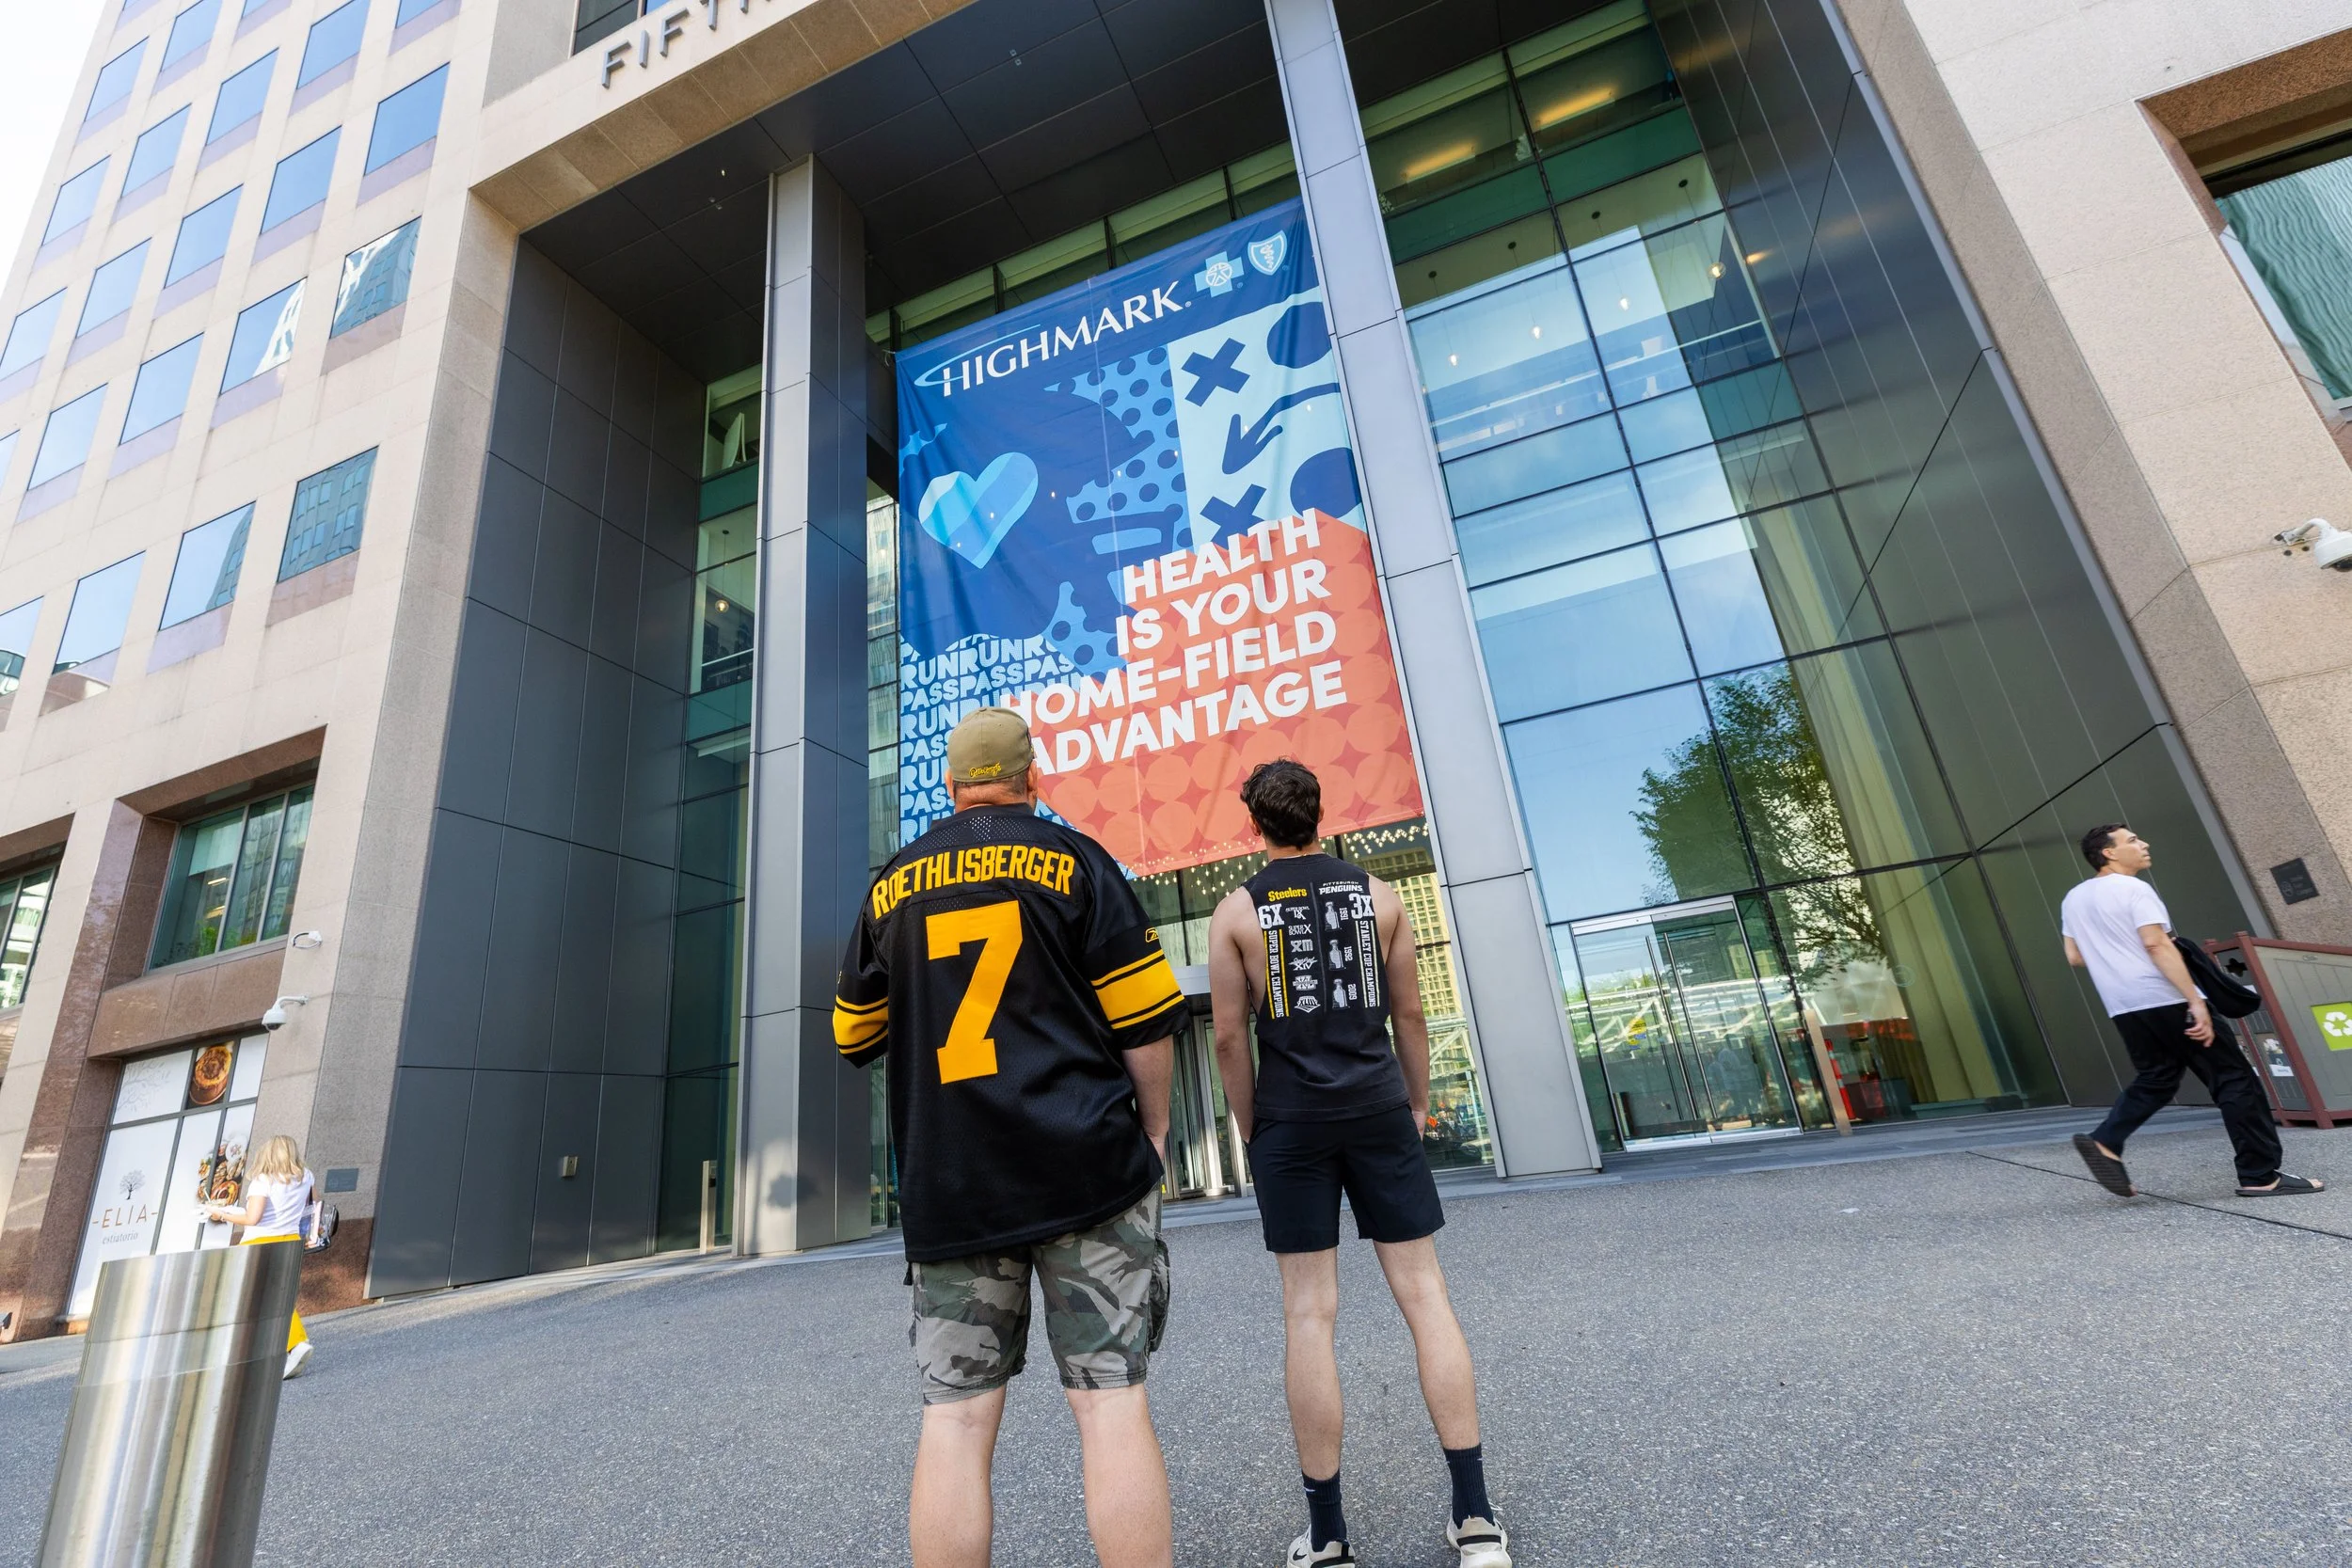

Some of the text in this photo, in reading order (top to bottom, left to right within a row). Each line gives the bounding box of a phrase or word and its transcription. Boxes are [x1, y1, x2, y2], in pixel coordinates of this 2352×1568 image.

[601, 0, 771, 88] FIFT
[1123, 508, 1321, 604] HEALTH
[1116, 559, 1330, 655] IS YOUR
[1000, 611, 1337, 728] HOME-FIELD
[1032, 661, 1347, 776] ADVANTAGE
[872, 845, 1075, 920] ROETHLISBERGER
[1258, 903, 1285, 929] 6X
[1268, 888, 1308, 901] Steelers
[1318, 884, 1364, 895] PENGUINS
[1340, 908, 1349, 921] 1991
[1348, 893, 1375, 919] 3X
[925, 900, 1024, 1084] 7
[1268, 930, 1284, 1018] SUPER BOWL CHAMPIONS
[1359, 921, 1376, 1007] STANLEY CUP CHAMPIONS
